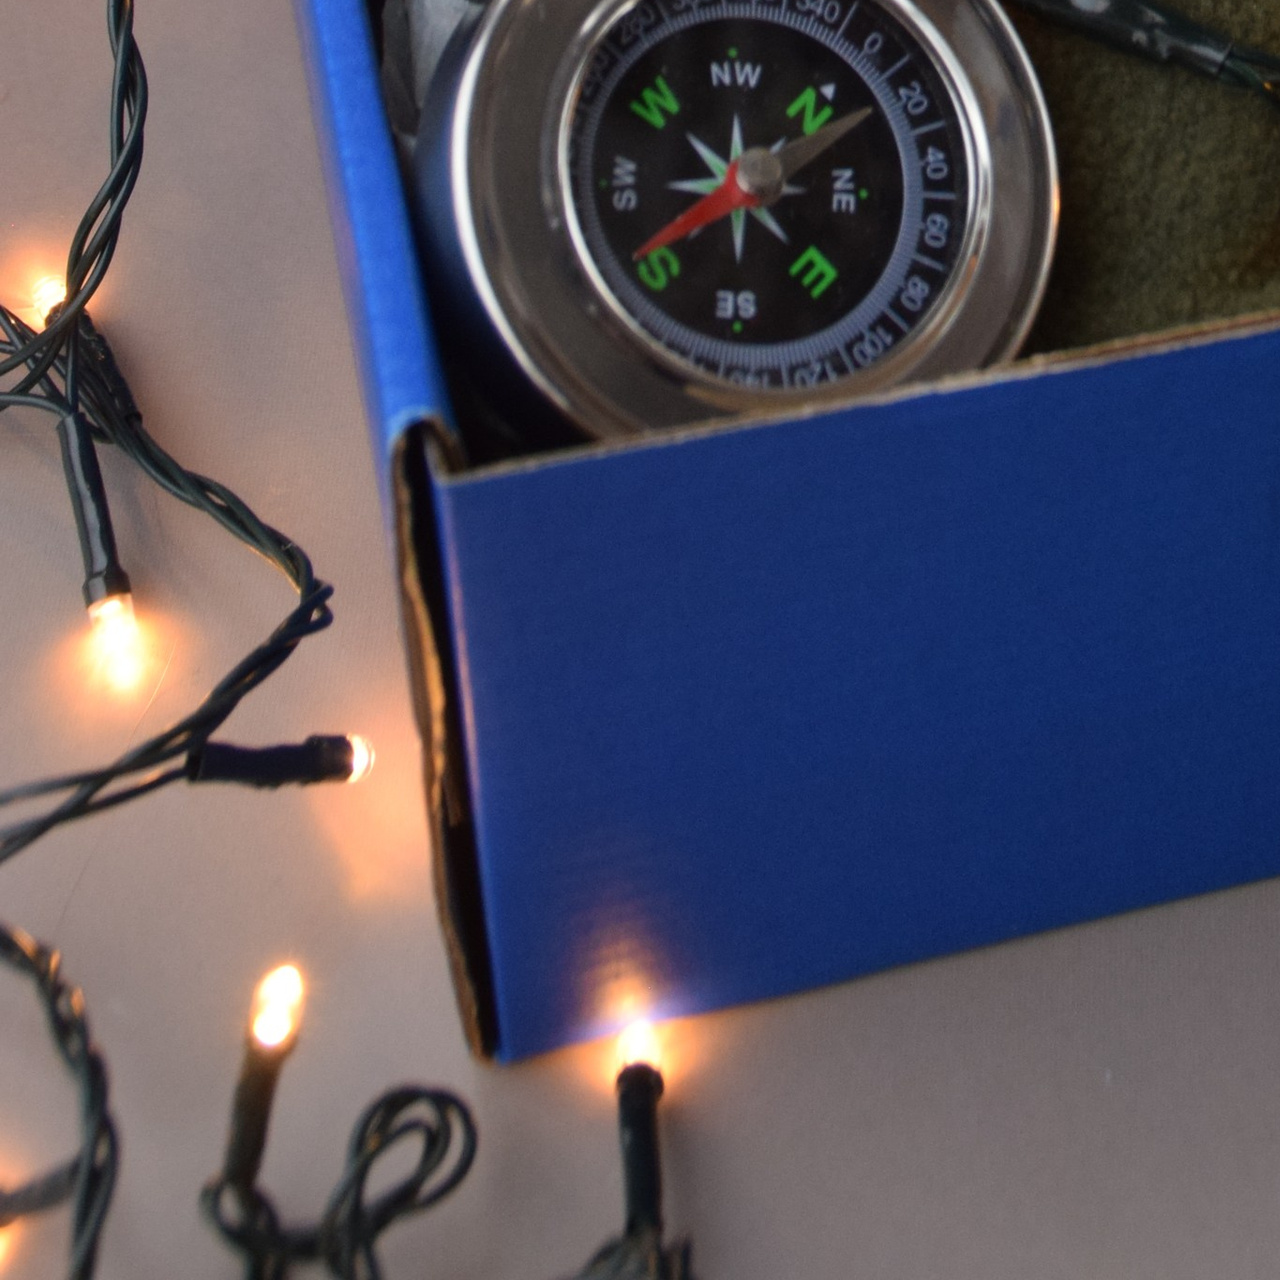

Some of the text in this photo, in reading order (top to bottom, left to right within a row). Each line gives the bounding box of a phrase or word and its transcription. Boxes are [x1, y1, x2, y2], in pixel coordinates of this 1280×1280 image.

[862, 31, 884, 55] 0
[710, 61, 762, 89] NW
[630, 75, 681, 130] W
[785, 86, 834, 136] N
[898, 80, 928, 117] 20
[924, 146, 949, 180] 40
[612, 156, 638, 212] SW
[831, 169, 856, 214] NE
[923, 213, 948, 248] 60
[636, 245, 681, 291] S
[789, 245, 839, 299] E
[714, 288, 758, 319] SE
[900, 274, 930, 312] 80
[852, 326, 894, 367] 100
